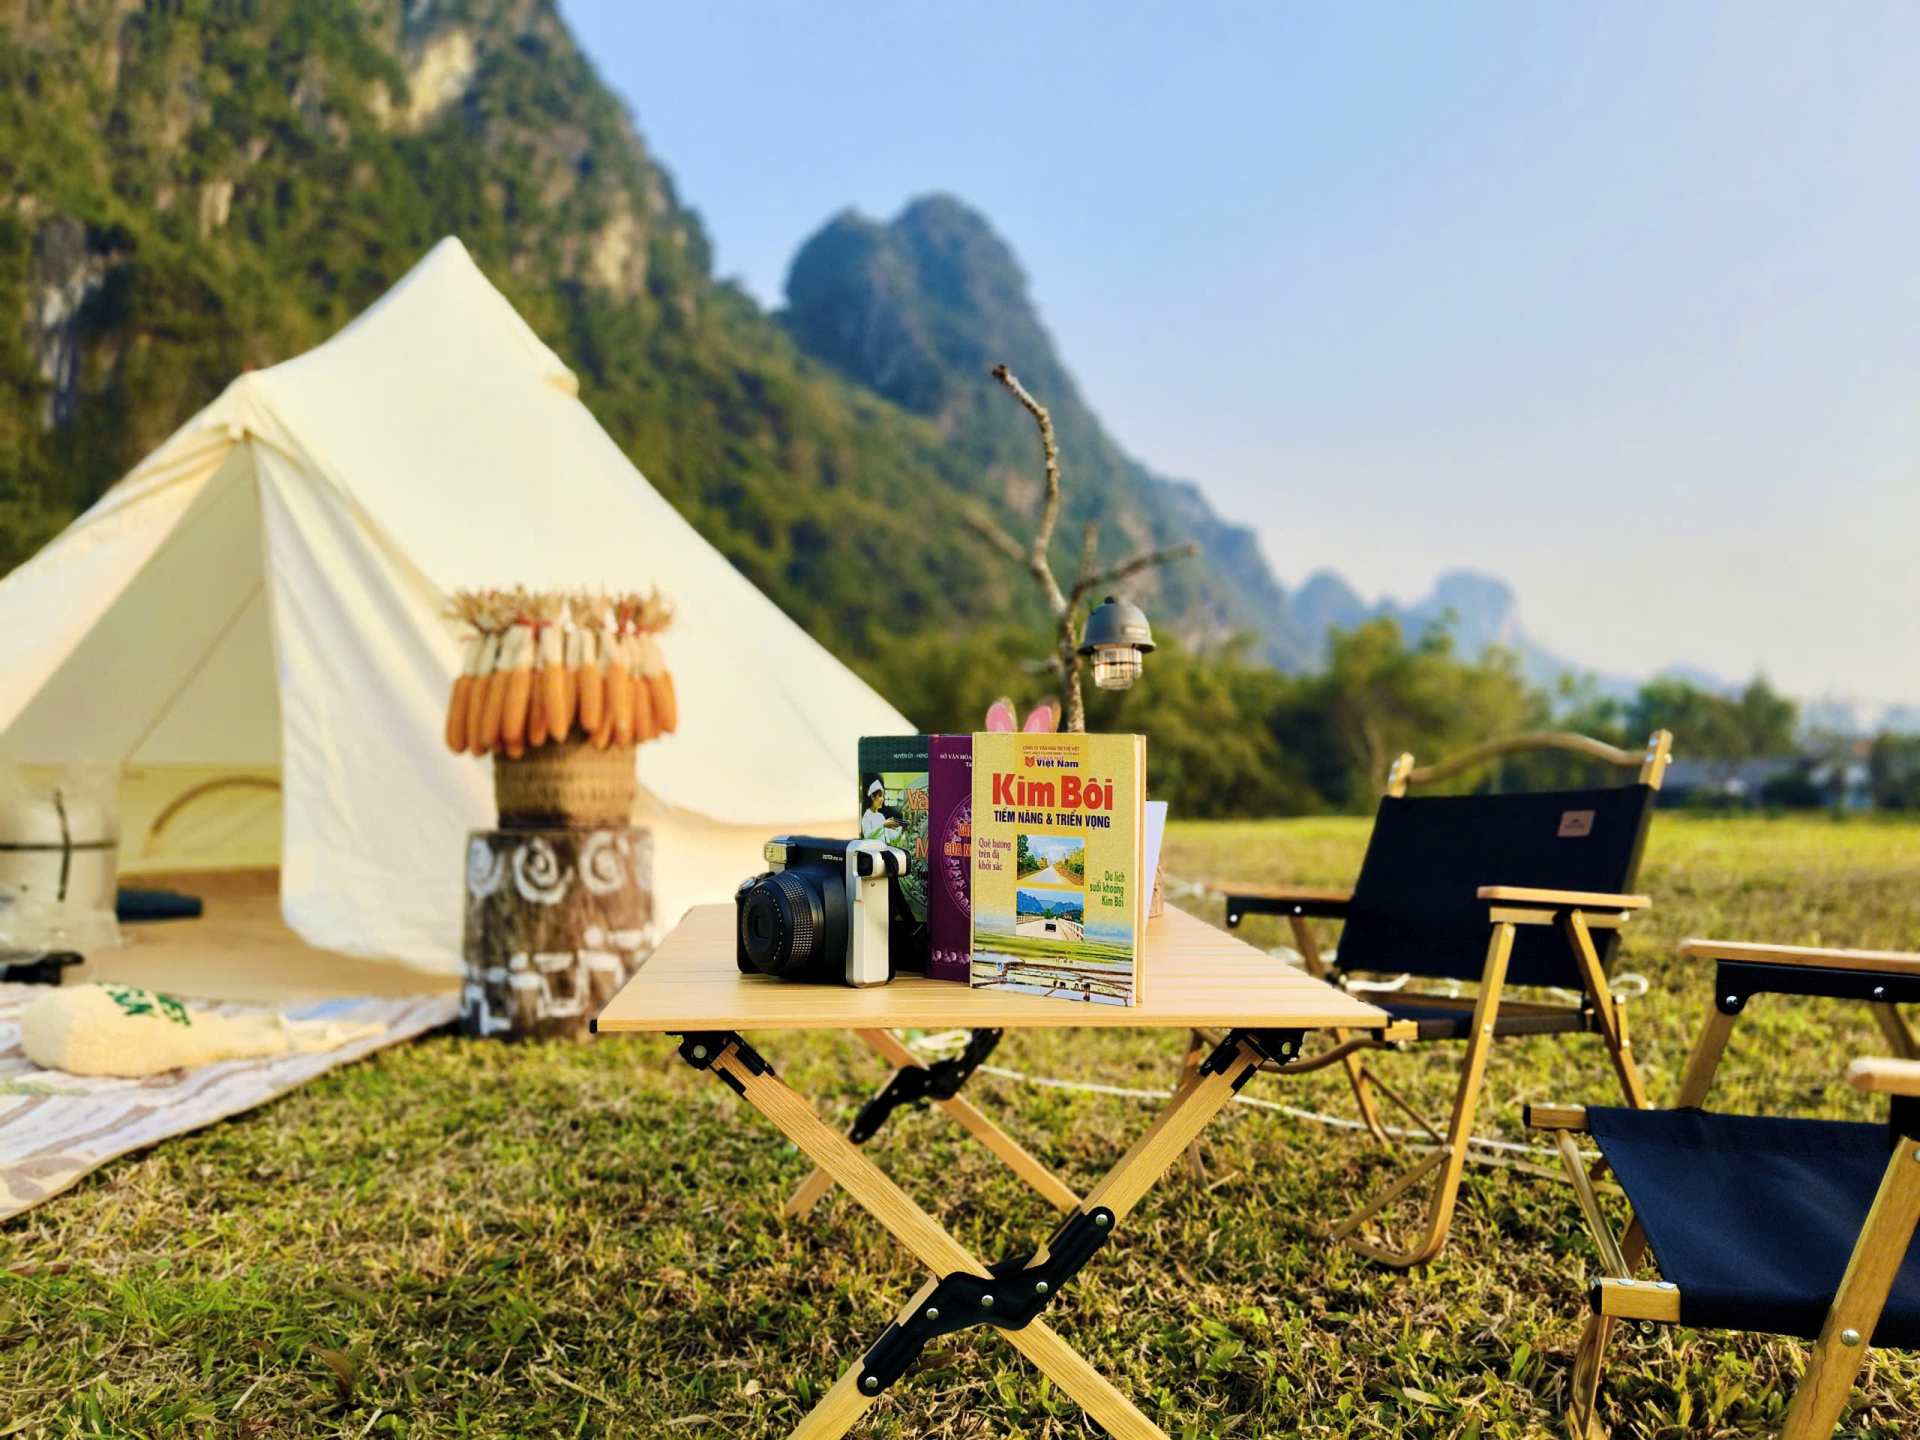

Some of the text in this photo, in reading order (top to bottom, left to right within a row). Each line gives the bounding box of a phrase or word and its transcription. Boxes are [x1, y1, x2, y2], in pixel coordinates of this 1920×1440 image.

[1036, 758, 1054, 768] Việt
[992, 773, 1113, 810] Kim Bôi
[906, 788, 929, 810] Vă
[1018, 810, 1043, 824] NĂNG
[1046, 813, 1052, 825] &
[1056, 809, 1082, 826] TRIỂN
[1085, 815, 1110, 830] VỌNG
[944, 837, 962, 856] CỦA
[978, 837, 1011, 851] Quê hương
[978, 849, 990, 858] trên
[1105, 871, 1113, 881] Du
[1090, 879, 1101, 892] suối
[1102, 895, 1124, 907] Kim Bôi
